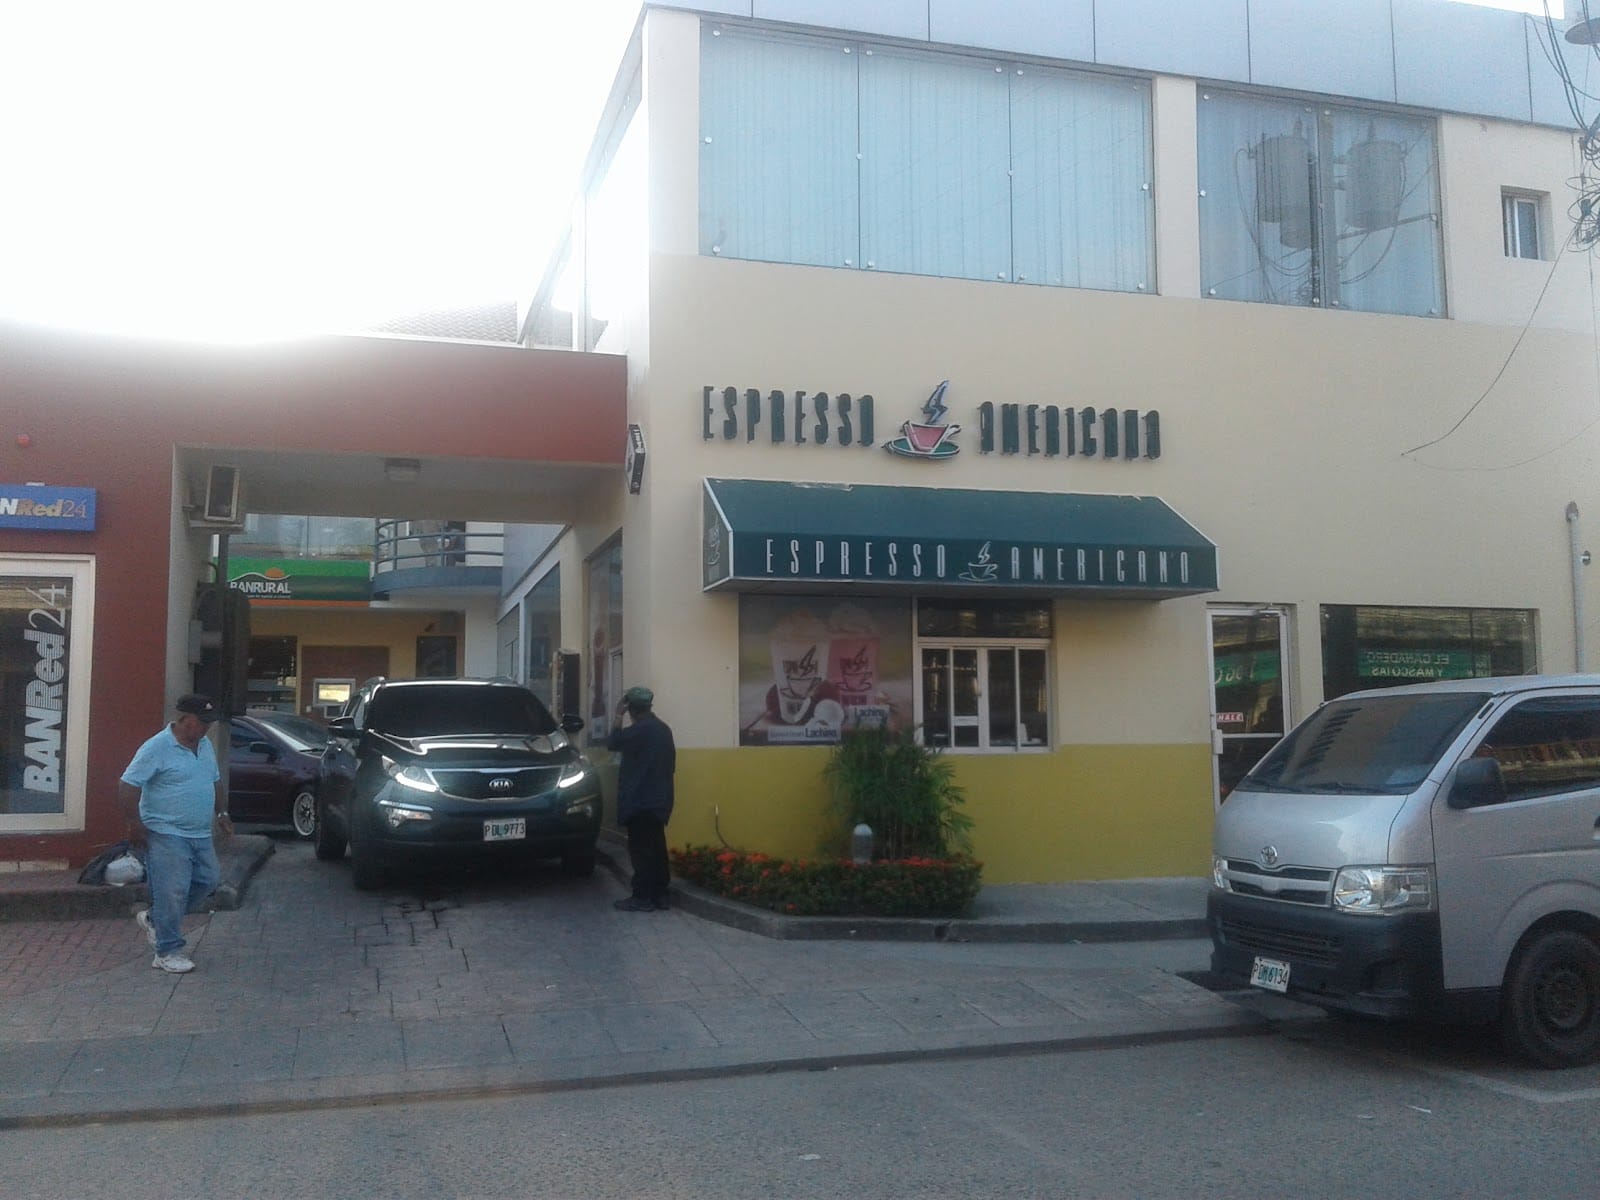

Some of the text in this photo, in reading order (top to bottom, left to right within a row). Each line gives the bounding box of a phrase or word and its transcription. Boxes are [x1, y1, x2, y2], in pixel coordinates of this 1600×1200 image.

[703, 386, 874, 447] ESPRESSO
[977, 401, 1161, 460] AMERICANO
[229, 581, 291, 594] BANRURAL
[766, 538, 946, 578] ESPRESSO
[1010, 546, 1189, 584] AMERICANO
[24, 584, 67, 793] BANRed24
